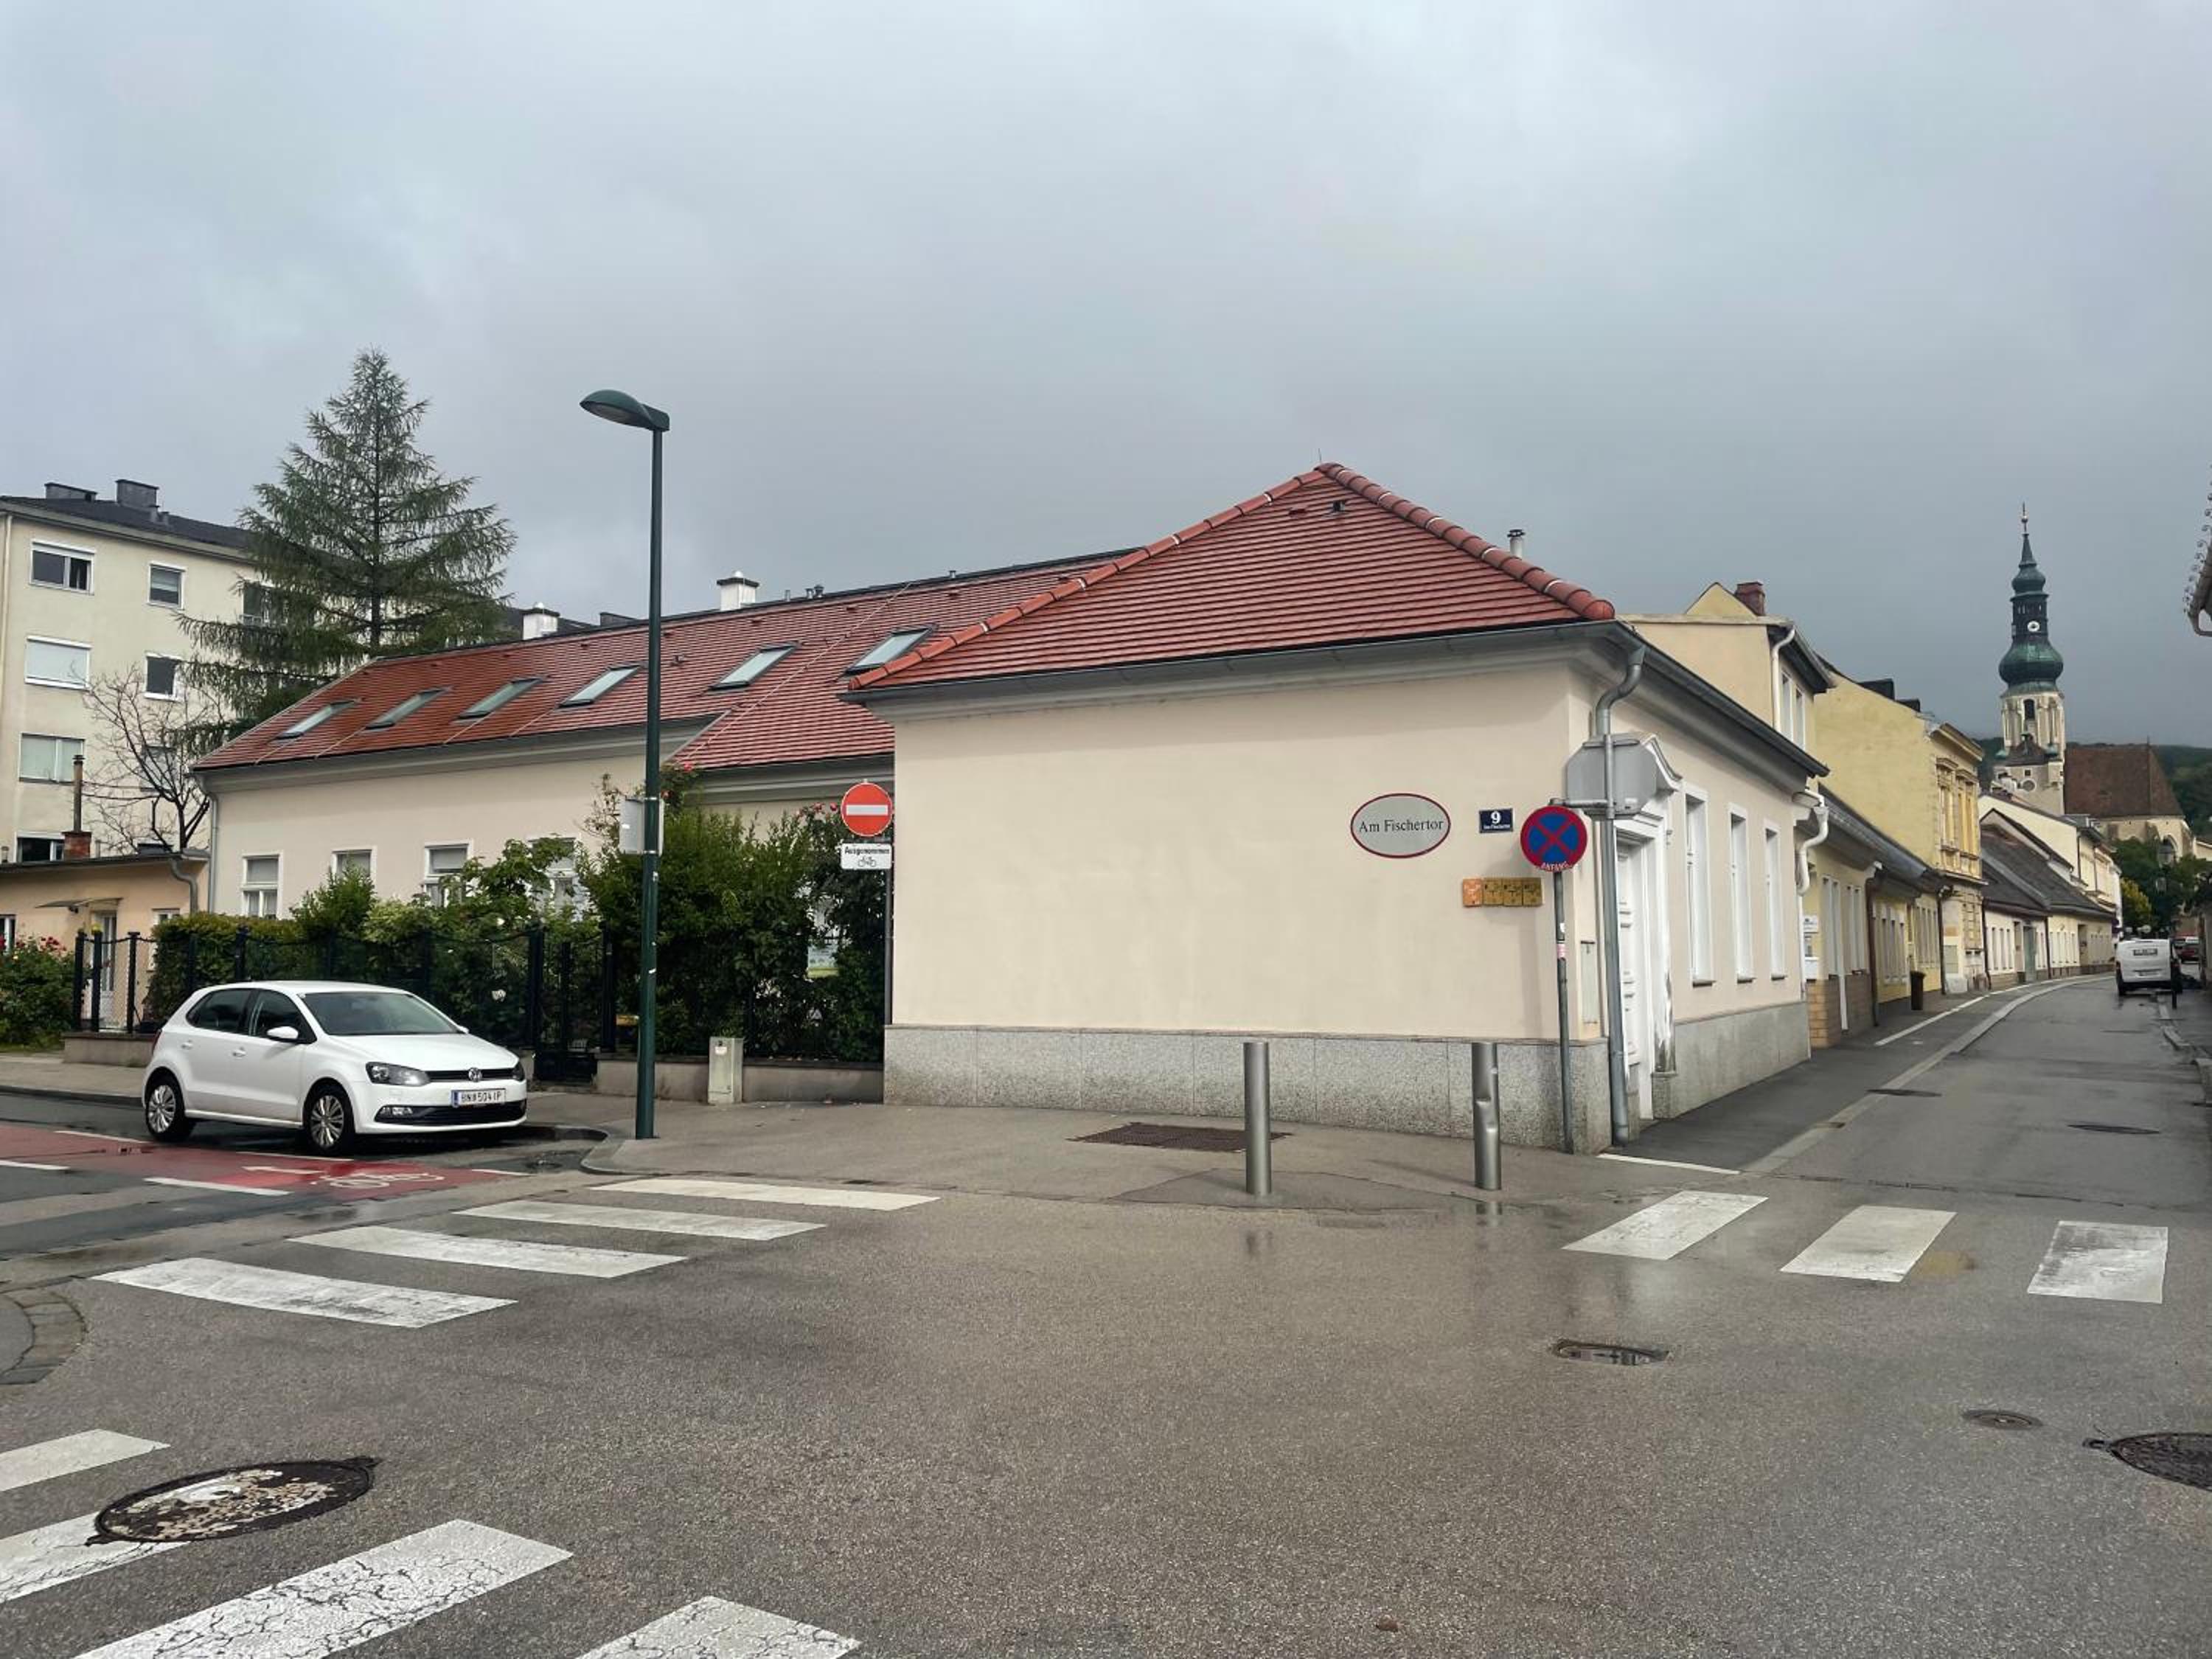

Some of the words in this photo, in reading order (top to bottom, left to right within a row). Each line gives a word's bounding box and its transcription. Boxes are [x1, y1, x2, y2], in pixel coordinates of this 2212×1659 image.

[1490, 810, 1501, 824] 9
[1359, 821, 1380, 832] Am
[1384, 818, 1444, 832] Fischertor
[844, 846, 890, 856] Ausgenommen
